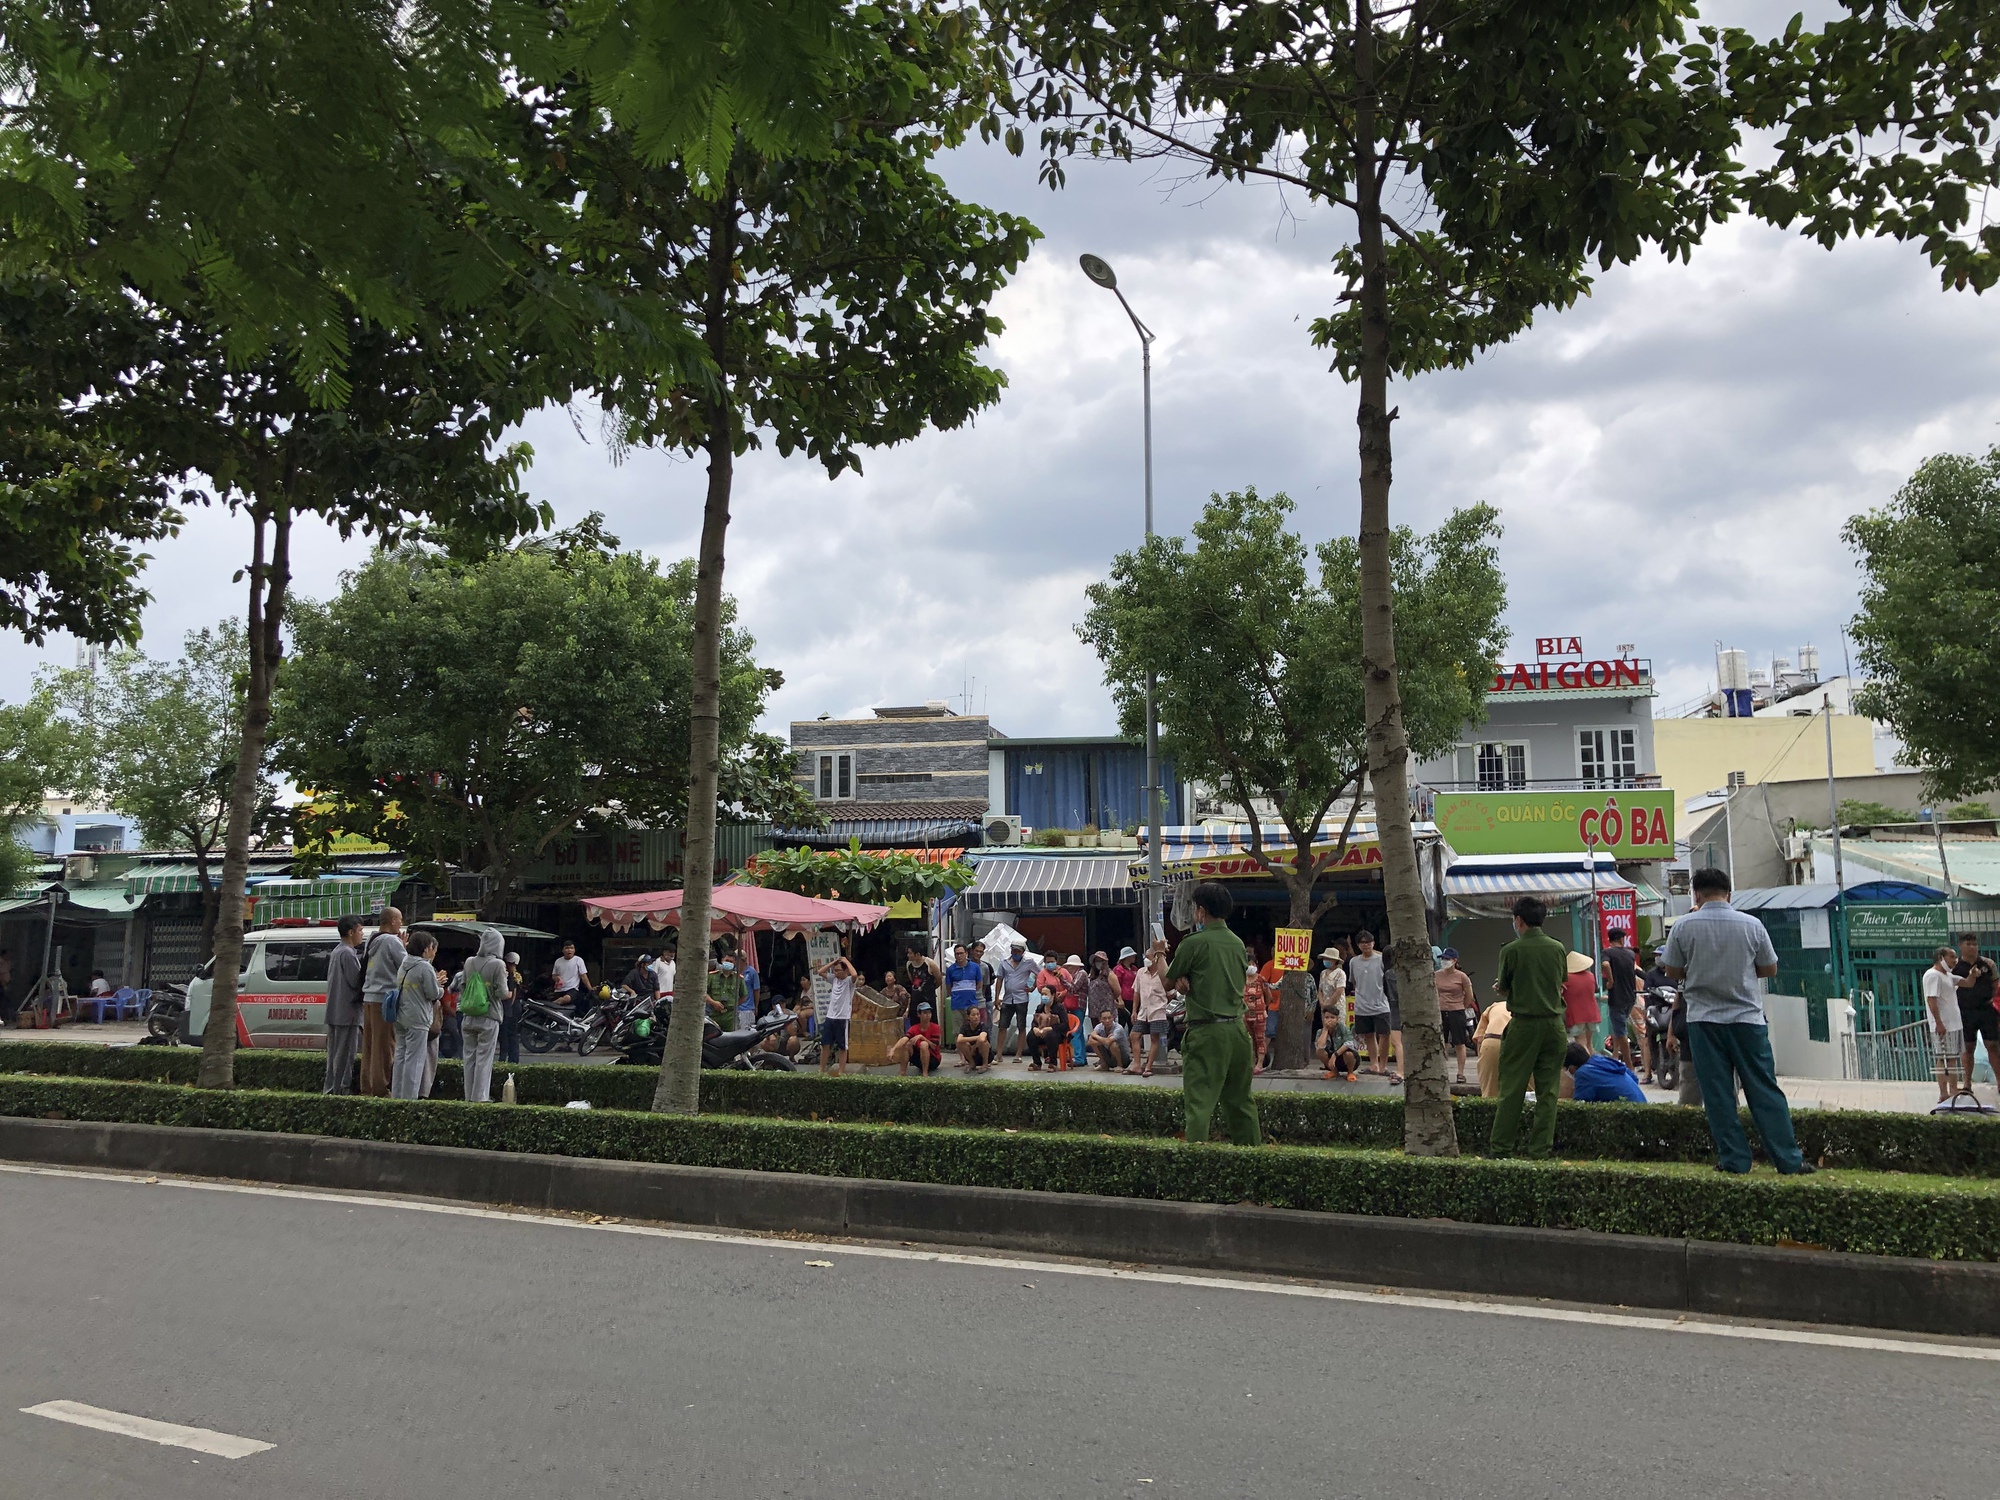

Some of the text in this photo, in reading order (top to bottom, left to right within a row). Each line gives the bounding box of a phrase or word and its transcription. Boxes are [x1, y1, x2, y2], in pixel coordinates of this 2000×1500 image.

[1538, 637, 1583, 655] BIA
[1496, 796, 1669, 847] QUÁN ỐC CÔ BA
[1129, 864, 1168, 877] QUN
[1602, 893, 1632, 910] SALE
[1606, 914, 1631, 930] 20K
[1892, 909, 1931, 926] Thanh
[1277, 931, 1295, 953] BÚN
[1285, 957, 1299, 966] 30K
[267, 1008, 308, 1020] AMBULANCE
